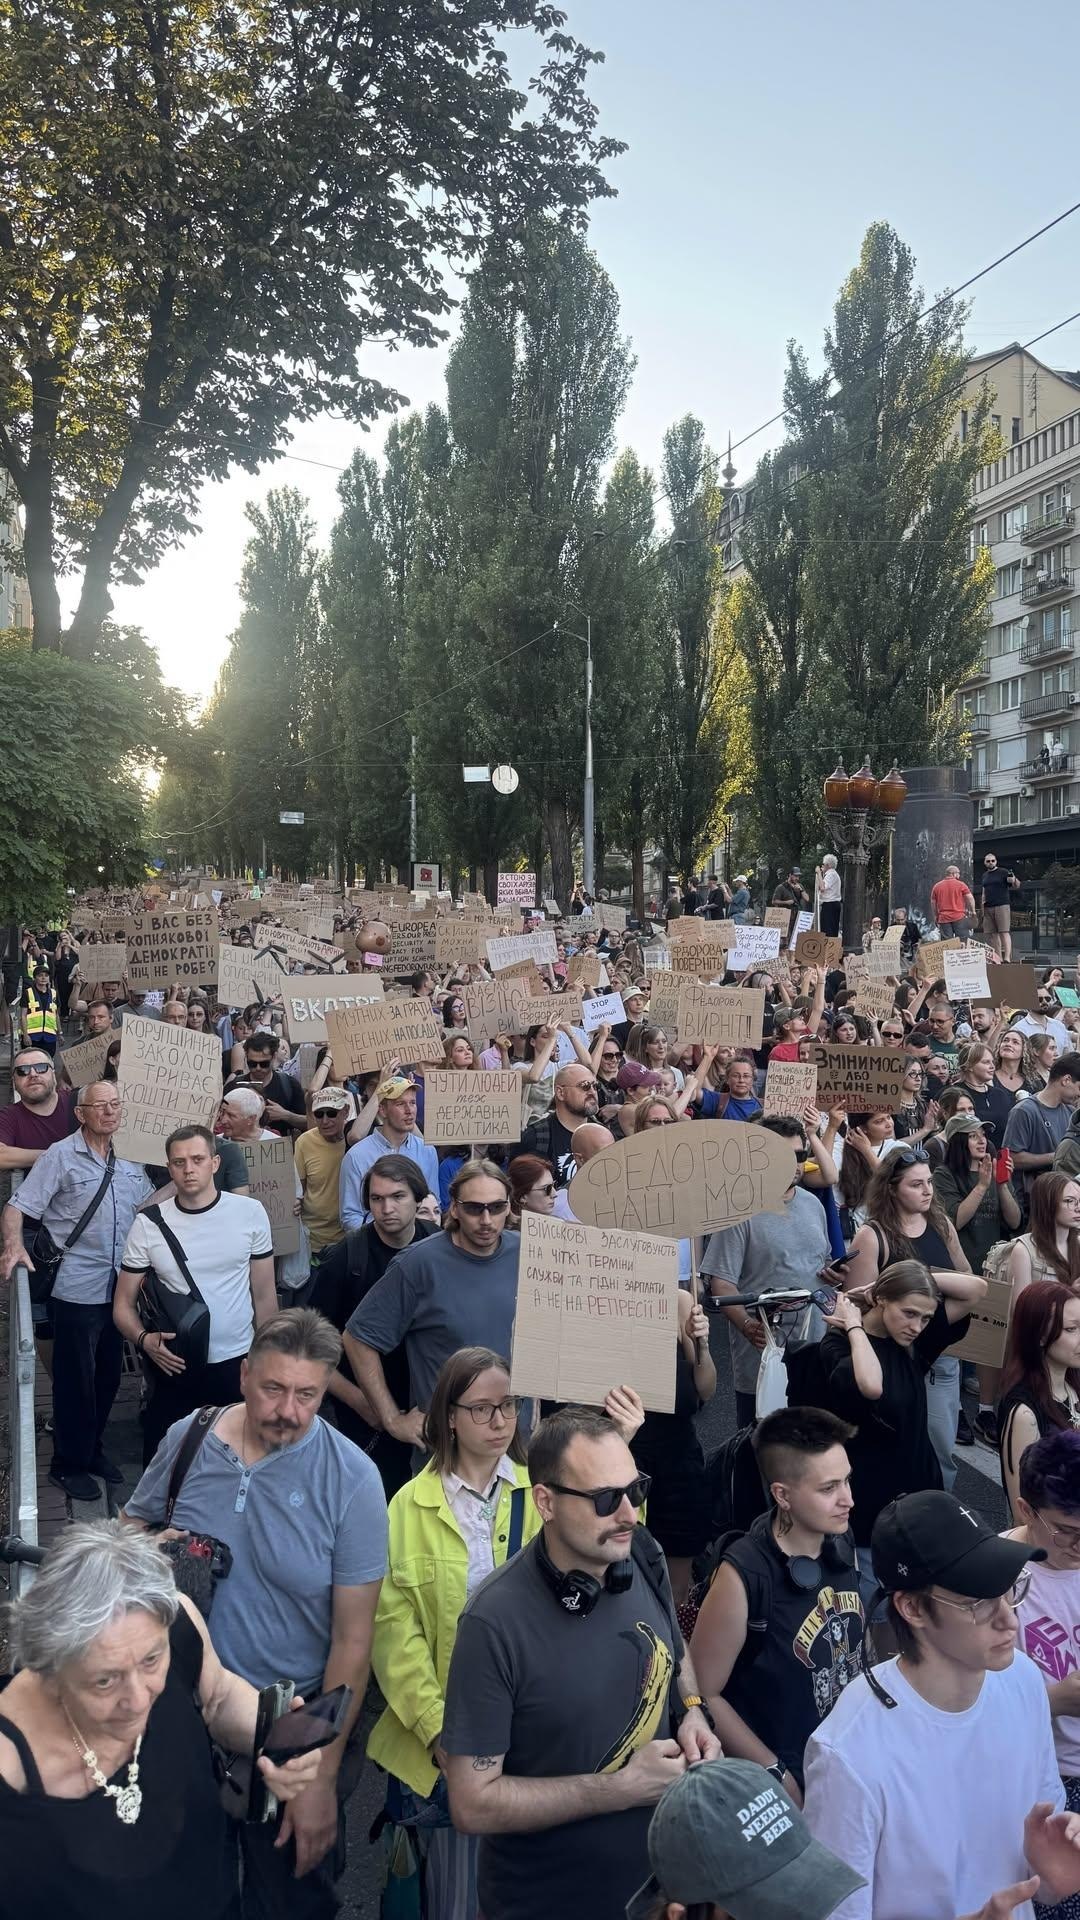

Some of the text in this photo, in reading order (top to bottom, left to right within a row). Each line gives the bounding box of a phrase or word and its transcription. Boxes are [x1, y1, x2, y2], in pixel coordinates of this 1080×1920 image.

[134, 920, 143, 930] У
[151, 916, 180, 930] ВАС
[185, 914, 213, 927] БЕЗ
[391, 921, 437, 933] EUROPEA
[127, 930, 209, 947] КОПНЯКОВОЇ
[129, 945, 214, 964] ДЕМОКРАТІЇ
[131, 967, 149, 979] НІЦ
[154, 965, 168, 977] НЕ
[175, 960, 216, 975] РОБЕ?
[591, 999, 609, 1010] STOP
[685, 986, 743, 1007] ФЕДОРОВА
[135, 1039, 217, 1073] ЗАКОЛОТ
[351, 1053, 369, 1073] НЕ
[144, 1063, 214, 1094] ТРИВАЄ
[429, 1072, 517, 1093] ЧУТИ ЛЮДЕЙ
[846, 1071, 870, 1081] АБО
[122, 1082, 179, 1110] КОШТИ
[436, 1105, 510, 1120] ДЕРЖАВНА
[436, 1121, 510, 1137] ПОЛІТИКА
[260, 1142, 286, 1165] МО
[588, 1134, 770, 1195] ФЕДОРОВ
[594, 1191, 675, 1229] НАШ
[527, 1217, 588, 1245] ВІЙСЬКОВІ
[528, 1243, 634, 1271] НА ЧІТКІ ТЕРМІНИ
[526, 1266, 665, 1295] СЛУЖБИ ТА ГІДНІ ЗАРПЛАТИ
[534, 1289, 541, 1307] А
[547, 1292, 560, 1308] НЕ
[565, 1295, 582, 1311] НА
[736, 1788, 778, 1825] DADDY
[742, 1799, 790, 1842] NEEDS A
[761, 1815, 793, 1846] BEER
